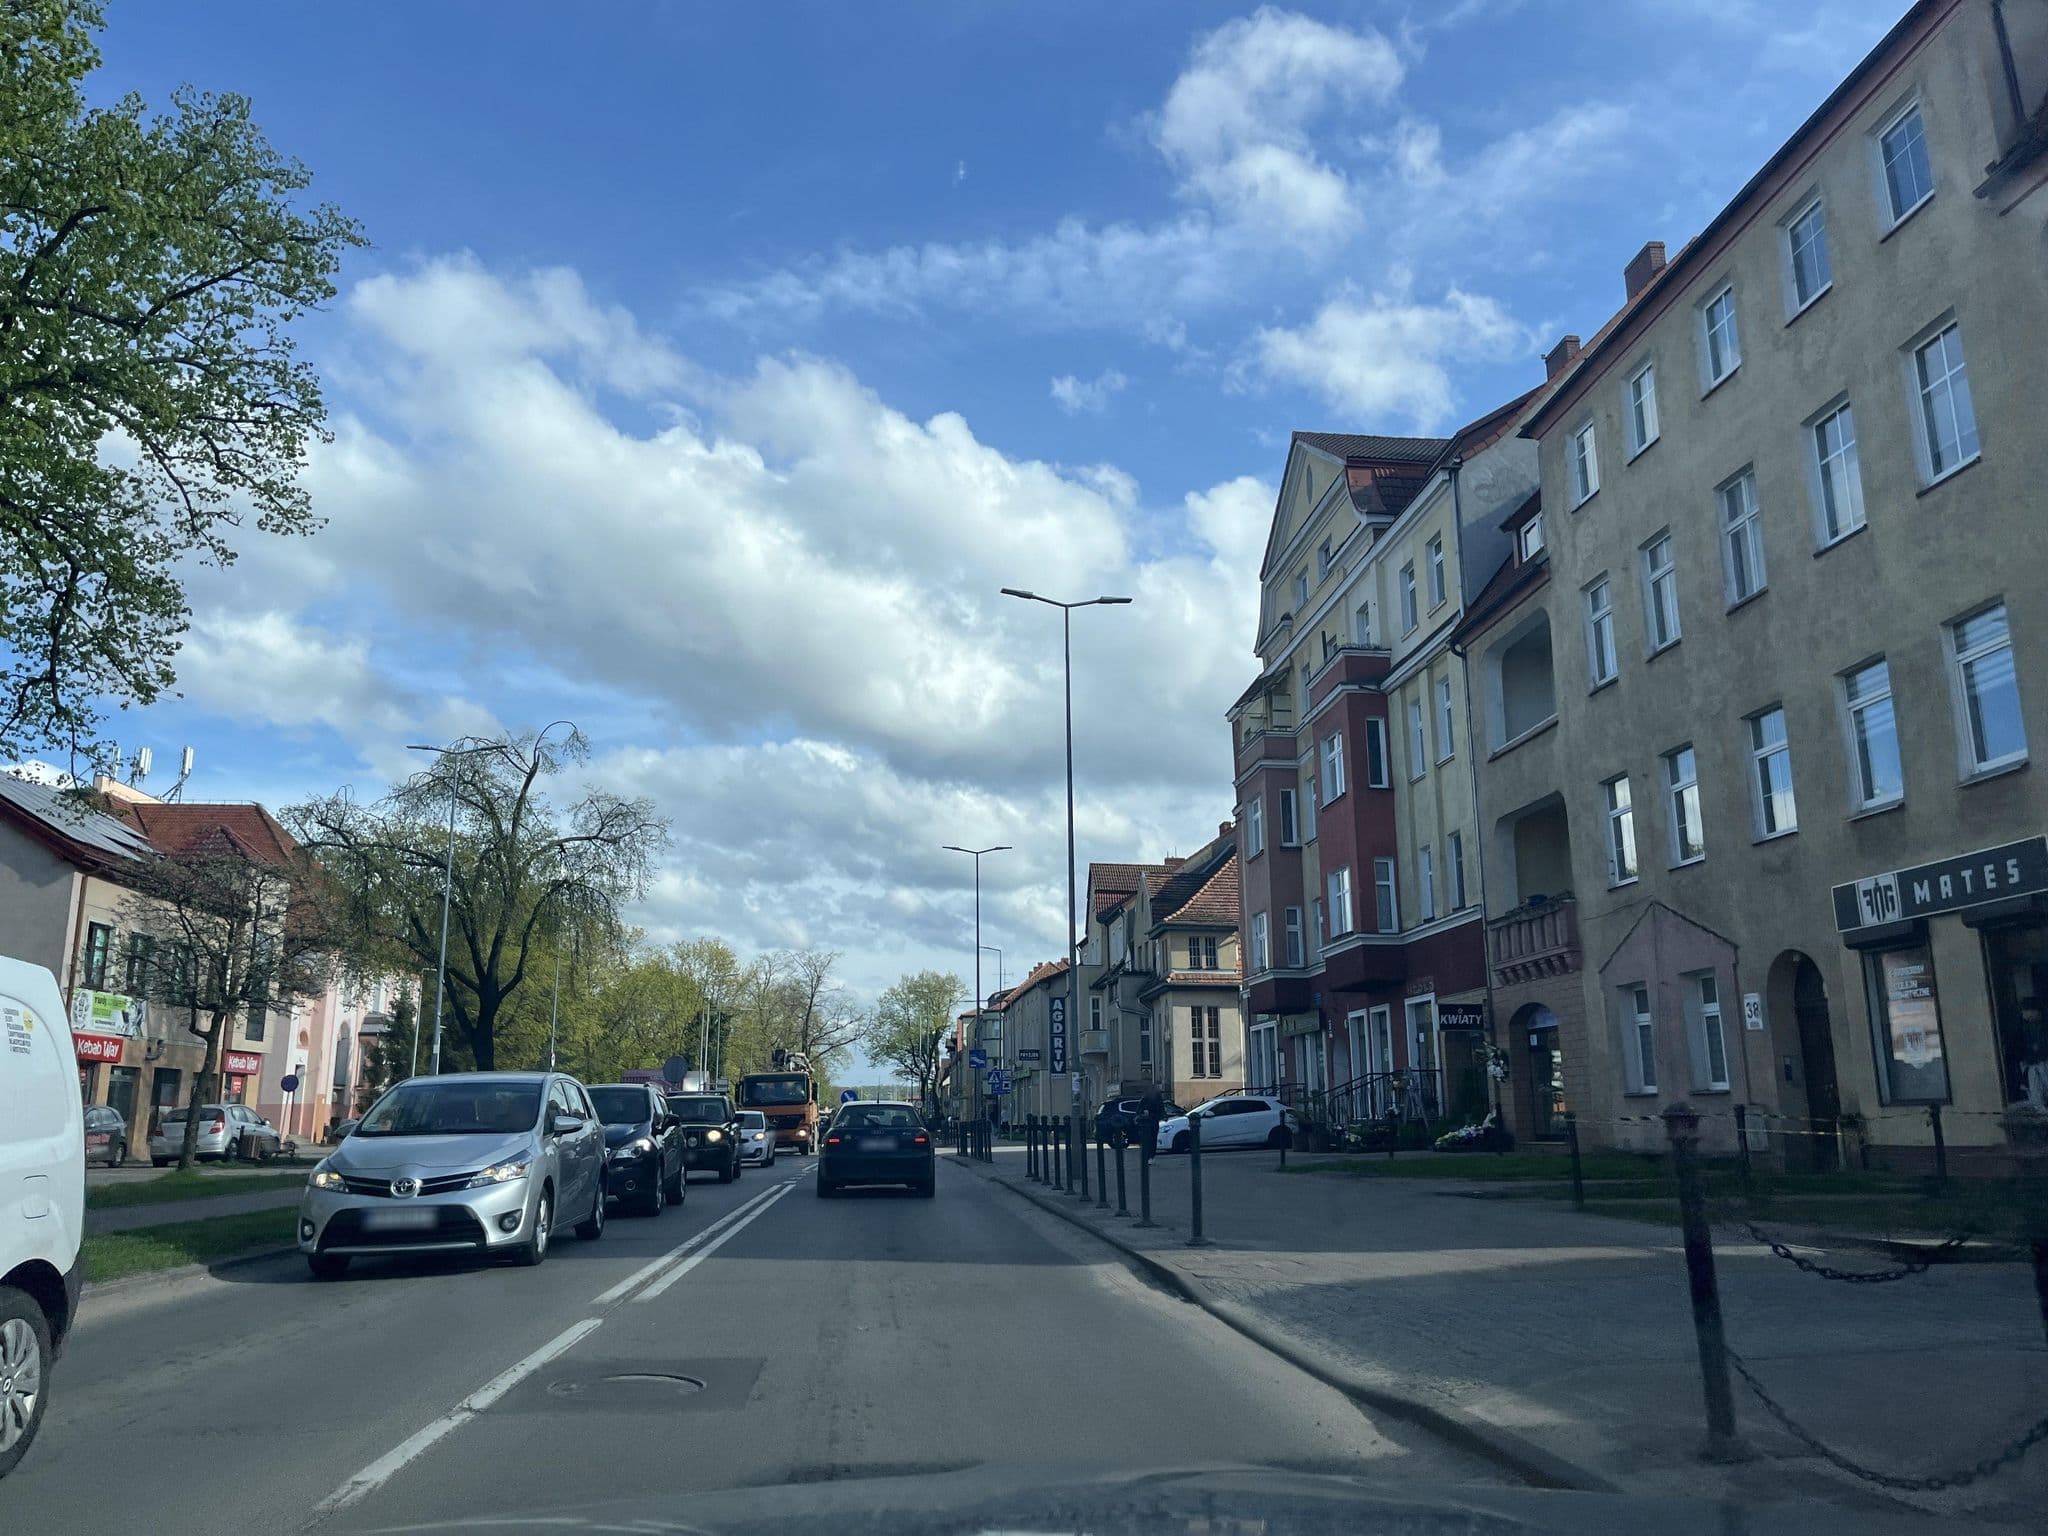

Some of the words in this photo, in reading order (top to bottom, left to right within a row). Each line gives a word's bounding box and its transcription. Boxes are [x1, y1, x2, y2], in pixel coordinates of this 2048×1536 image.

[1913, 858, 2020, 905] MATES
[1052, 999, 1064, 1034] AGD
[1440, 1014, 1482, 1025] KWIATY
[1745, 1001, 1761, 1019] 38
[77, 1038, 102, 1055] Kebab
[103, 1040, 120, 1058] Way
[1053, 1037, 1064, 1072] RTV
[228, 1055, 246, 1070] Kebab
[246, 1056, 258, 1071] Way
